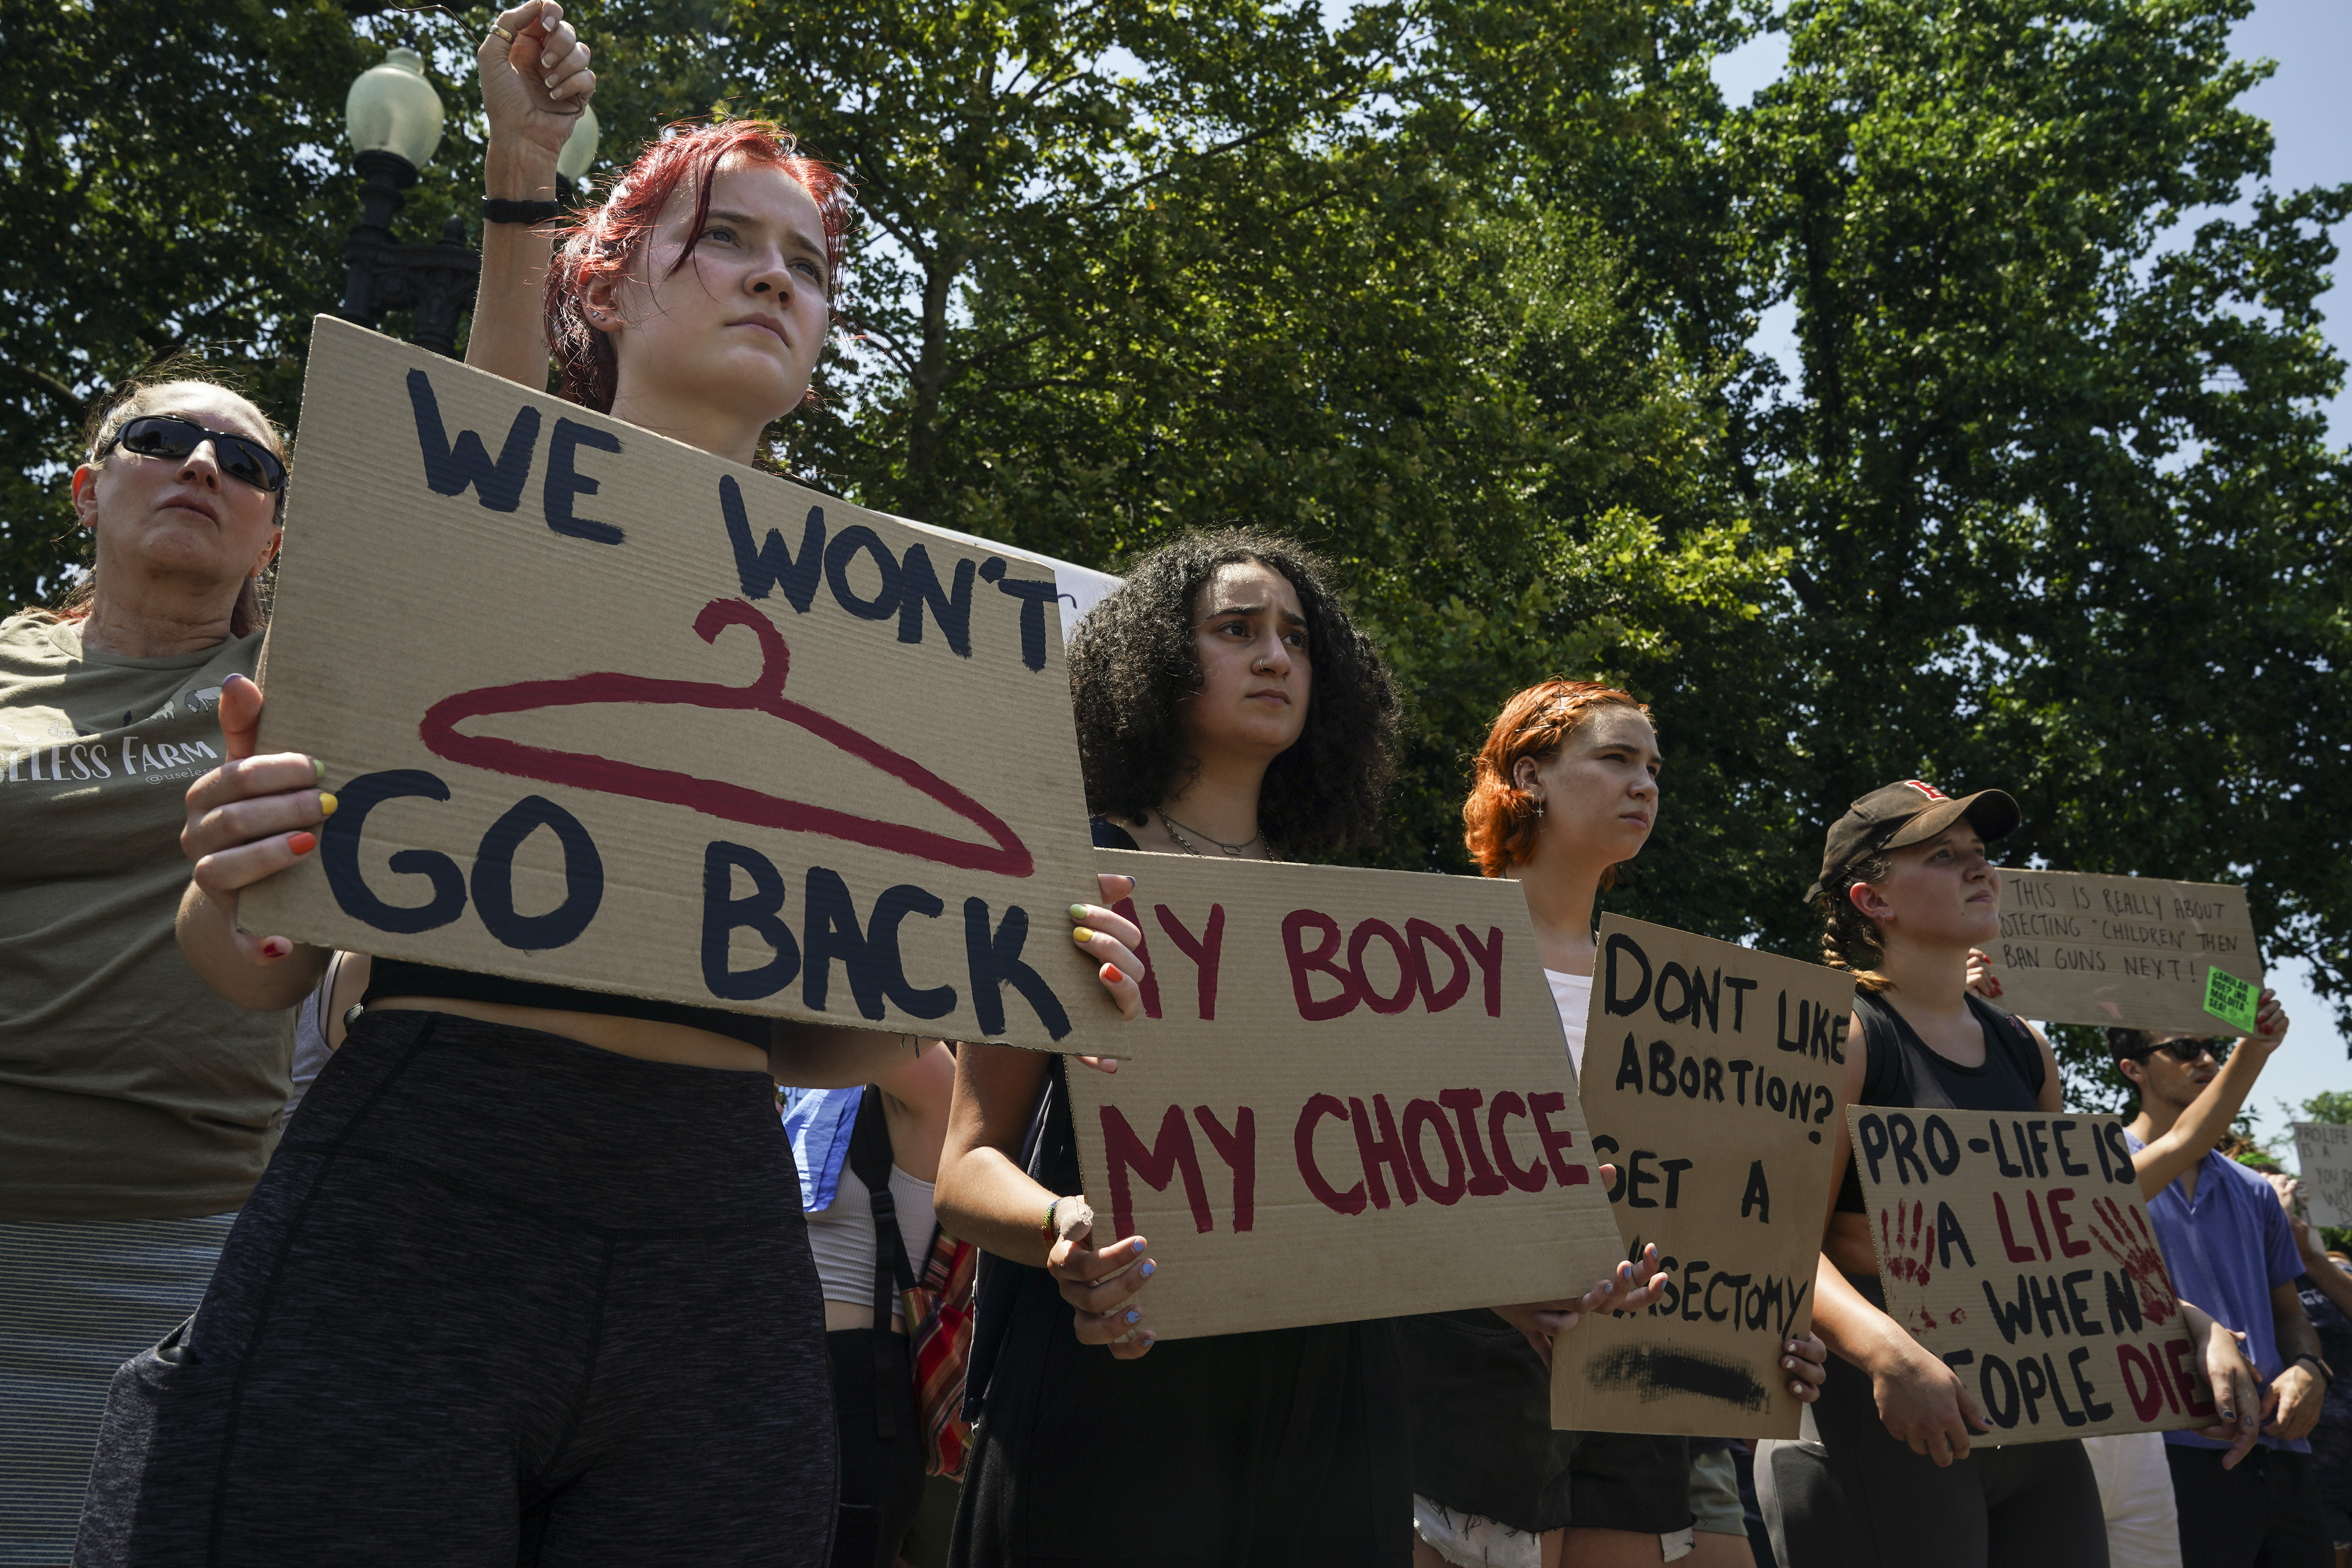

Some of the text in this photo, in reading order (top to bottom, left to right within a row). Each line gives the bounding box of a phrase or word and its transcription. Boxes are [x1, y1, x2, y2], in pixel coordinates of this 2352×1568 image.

[407, 368, 1058, 673] WE WON'T
[321, 769, 1073, 1042] GO BACK
[1998, 913, 2237, 951] OTECTING "CHILDREN" THEN
[2010, 878, 2225, 921] THIS IS REALLY ABOUT
[1282, 908, 1503, 1021] BODY
[2003, 944, 2195, 982] BAN GUNS NEXT!
[1778, 989, 1849, 1065] LIKE
[1616, 1032, 1833, 1144] ABORTION?
[1100, 1089, 1589, 1242] MY CHOICE
[1859, 1113, 2137, 1185] PRO-LIFE IS
[1741, 1159, 1770, 1223] A
[1937, 1188, 2091, 1268] A LIE
[1982, 1267, 2143, 1345] WHEN
[2117, 1339, 2220, 1423] DIE
